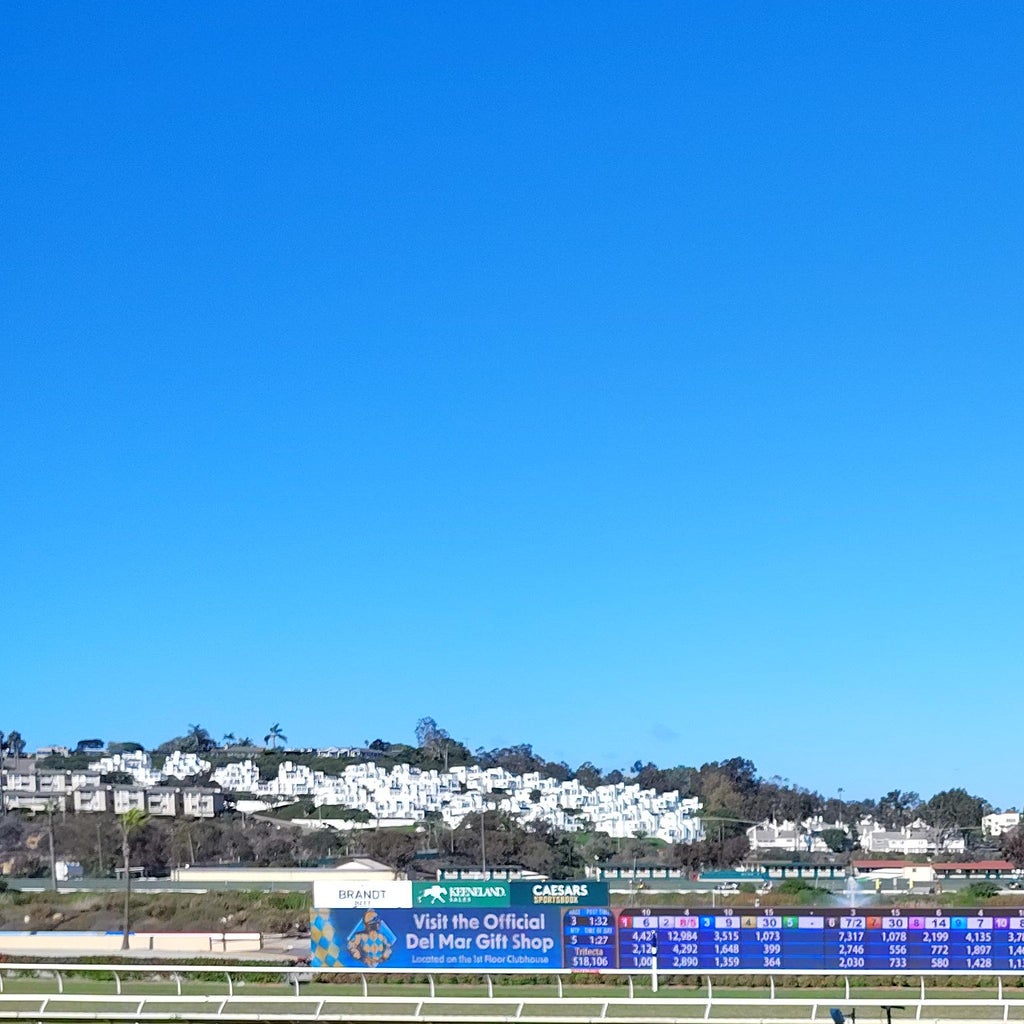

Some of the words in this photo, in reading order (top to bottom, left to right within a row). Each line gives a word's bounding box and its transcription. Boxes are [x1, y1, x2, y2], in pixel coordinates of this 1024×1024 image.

[338, 890, 386, 900] BRANDT
[533, 884, 588, 896] CAESARS
[413, 914, 448, 930] Visit
[452, 914, 479, 930] the
[483, 914, 545, 930] Official
[571, 916, 577, 926] 3
[589, 916, 608, 926] 1:32
[622, 918, 628, 928] 1
[643, 918, 650, 928] 6
[664, 918, 669, 928] 2
[704, 918, 710, 928] 3
[726, 918, 732, 928] 9
[746, 918, 751, 928] 4
[762, 918, 776, 928] 30
[787, 918, 793, 928] 5
[846, 918, 862, 928] 7/2
[872, 918, 876, 928] 7
[889, 918, 902, 928] 30
[914, 918, 920, 928] 8
[932, 918, 946, 928] 14
[956, 918, 962, 928] 9
[977, 918, 984, 928] 7
[996, 918, 1008, 928] 10
[572, 936, 578, 944] 5
[590, 936, 608, 944] 1:27
[632, 931, 657, 942] 4,42
[668, 931, 698, 942] 12,984
[714, 931, 739, 942] 3,515
[756, 931, 780, 942] 1,073
[838, 931, 864, 942] 7,317
[882, 931, 907, 942] 1,078
[923, 931, 949, 942] 2,199
[965, 931, 992, 942] 4,135
[406, 933, 434, 950] Del
[438, 933, 472, 950] Mar
[476, 933, 508, 950] Gift
[512, 933, 554, 953] Shop
[575, 948, 604, 956] Trifecta
[632, 944, 655, 954] 2,12
[672, 944, 698, 954] 4,292
[714, 944, 740, 954] 1,648
[763, 944, 780, 954] 399
[839, 944, 864, 954] 2,746
[889, 944, 906, 954] 556
[931, 944, 949, 954] 772
[966, 944, 992, 954] 1,897
[412, 955, 444, 964] Located
[446, 955, 457, 964] on
[459, 955, 472, 964] the
[474, 955, 483, 964] 1st
[484, 955, 506, 964] Floor
[507, 955, 549, 964] Clubhouse
[573, 956, 609, 968] $18,106
[633, 956, 655, 968] 1,00
[672, 956, 698, 968] 2,890
[715, 956, 740, 968] 1,359
[764, 956, 781, 968] 364
[839, 956, 864, 968] 2,030
[890, 956, 907, 968] 733
[931, 956, 949, 968] 580
[966, 956, 992, 968] 1,428
